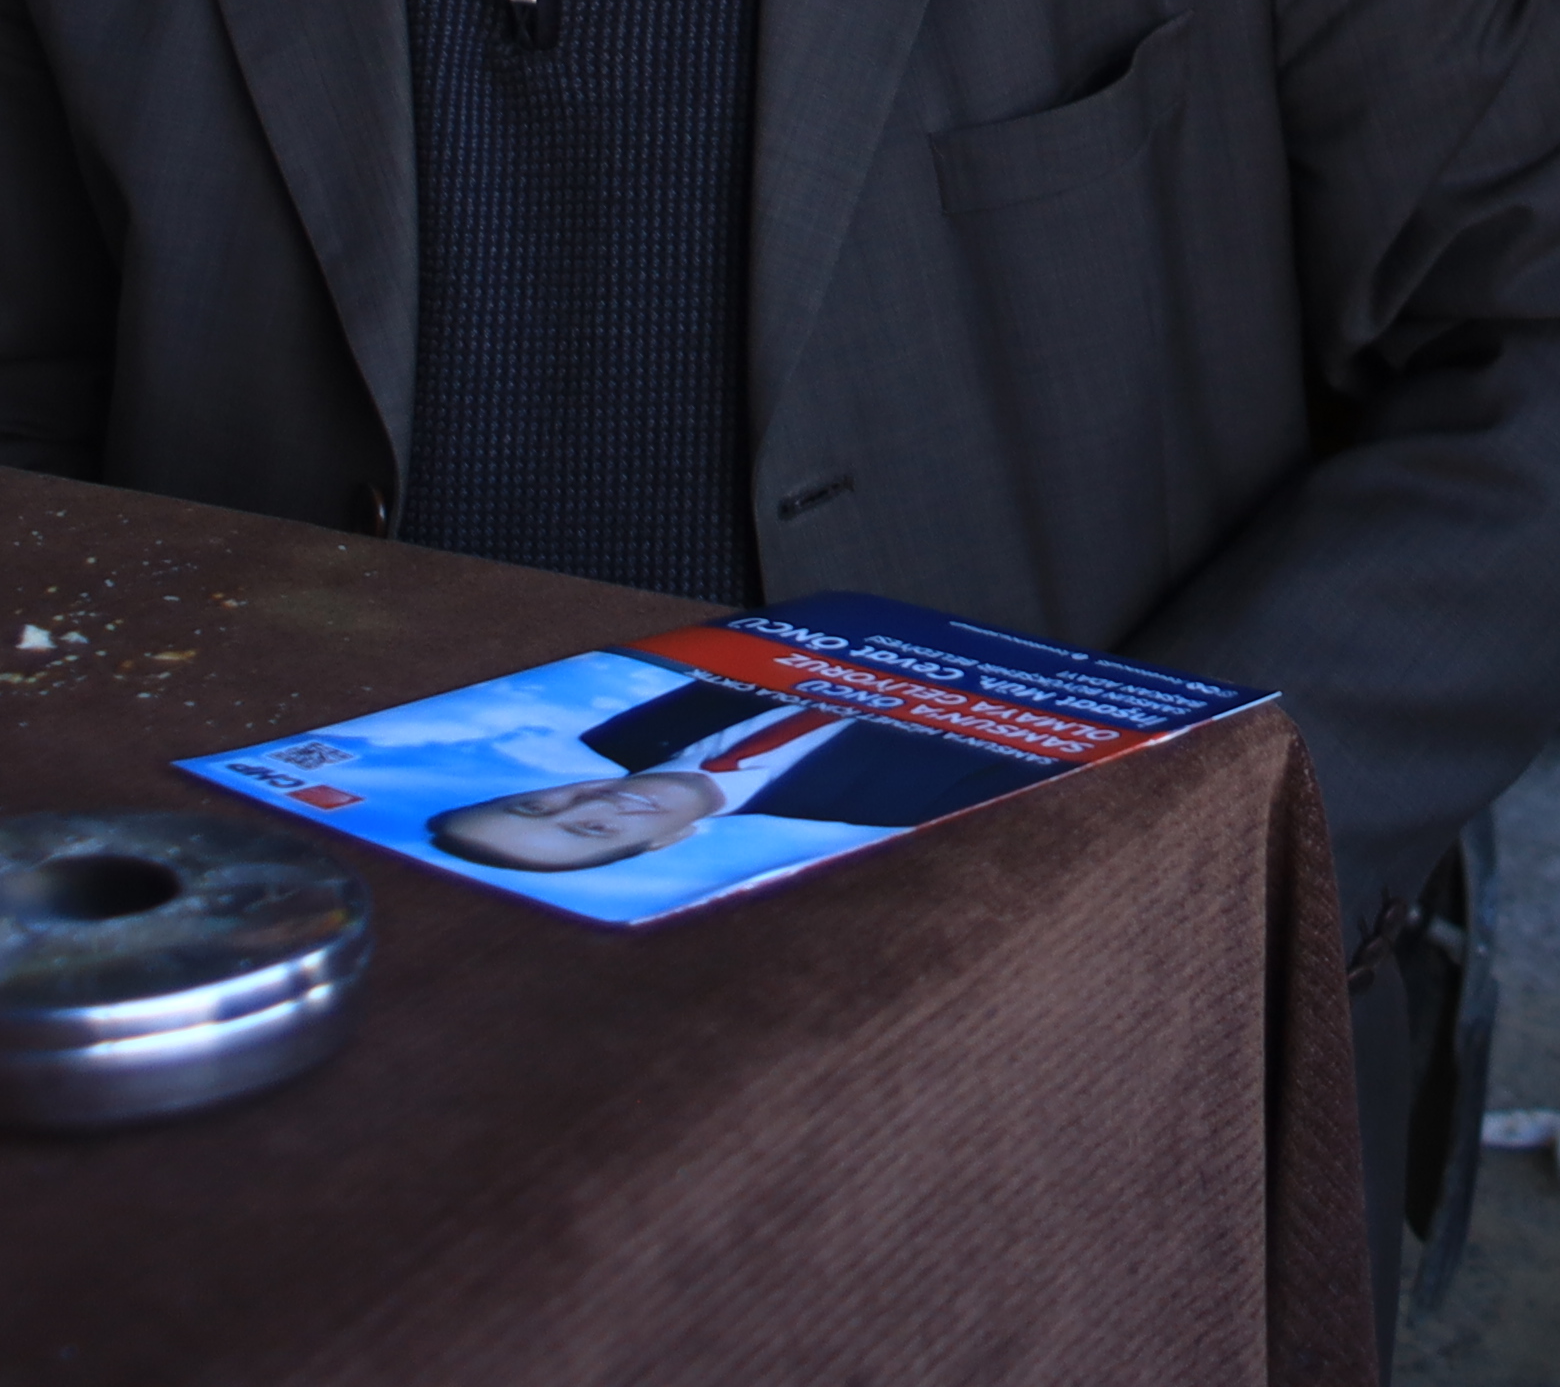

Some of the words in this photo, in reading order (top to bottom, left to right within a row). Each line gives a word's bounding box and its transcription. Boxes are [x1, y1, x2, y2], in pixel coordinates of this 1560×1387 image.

[730, 617, 849, 651] ÖNCÜ
[773, 652, 969, 706] GELİYORUZ
[850, 645, 965, 680] Cevat
[794, 679, 905, 709] ÖNCÜ
[910, 702, 1095, 754] SAMSUN'A
[970, 699, 1121, 742] OLMAYA
[225, 762, 306, 789] CHP
